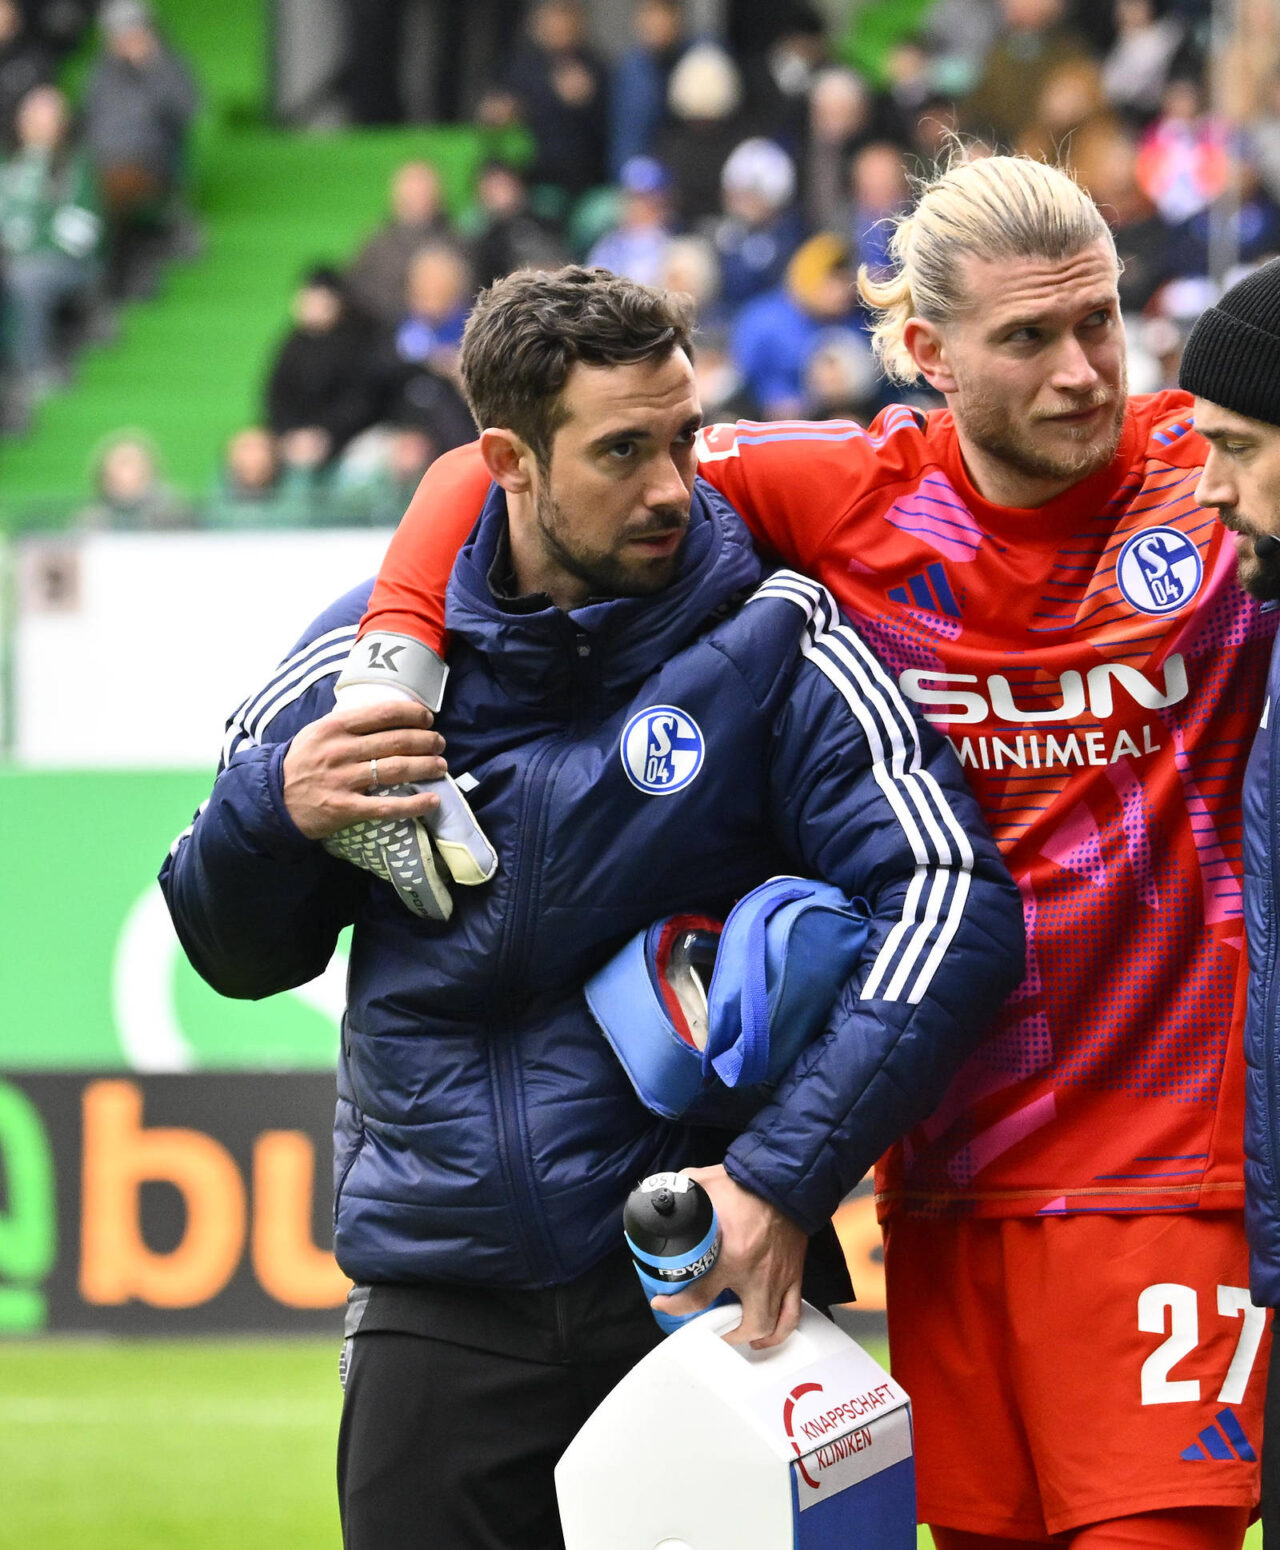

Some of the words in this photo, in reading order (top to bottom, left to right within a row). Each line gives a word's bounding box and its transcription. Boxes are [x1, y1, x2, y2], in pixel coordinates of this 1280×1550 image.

[899, 653, 1189, 724] SUN
[944, 725, 1161, 771] MINIMEAL
[1137, 1282, 1267, 1406] 27
[800, 1383, 895, 1441] KNAPPSCHAFT
[815, 1427, 873, 1471] KLINIKEN
